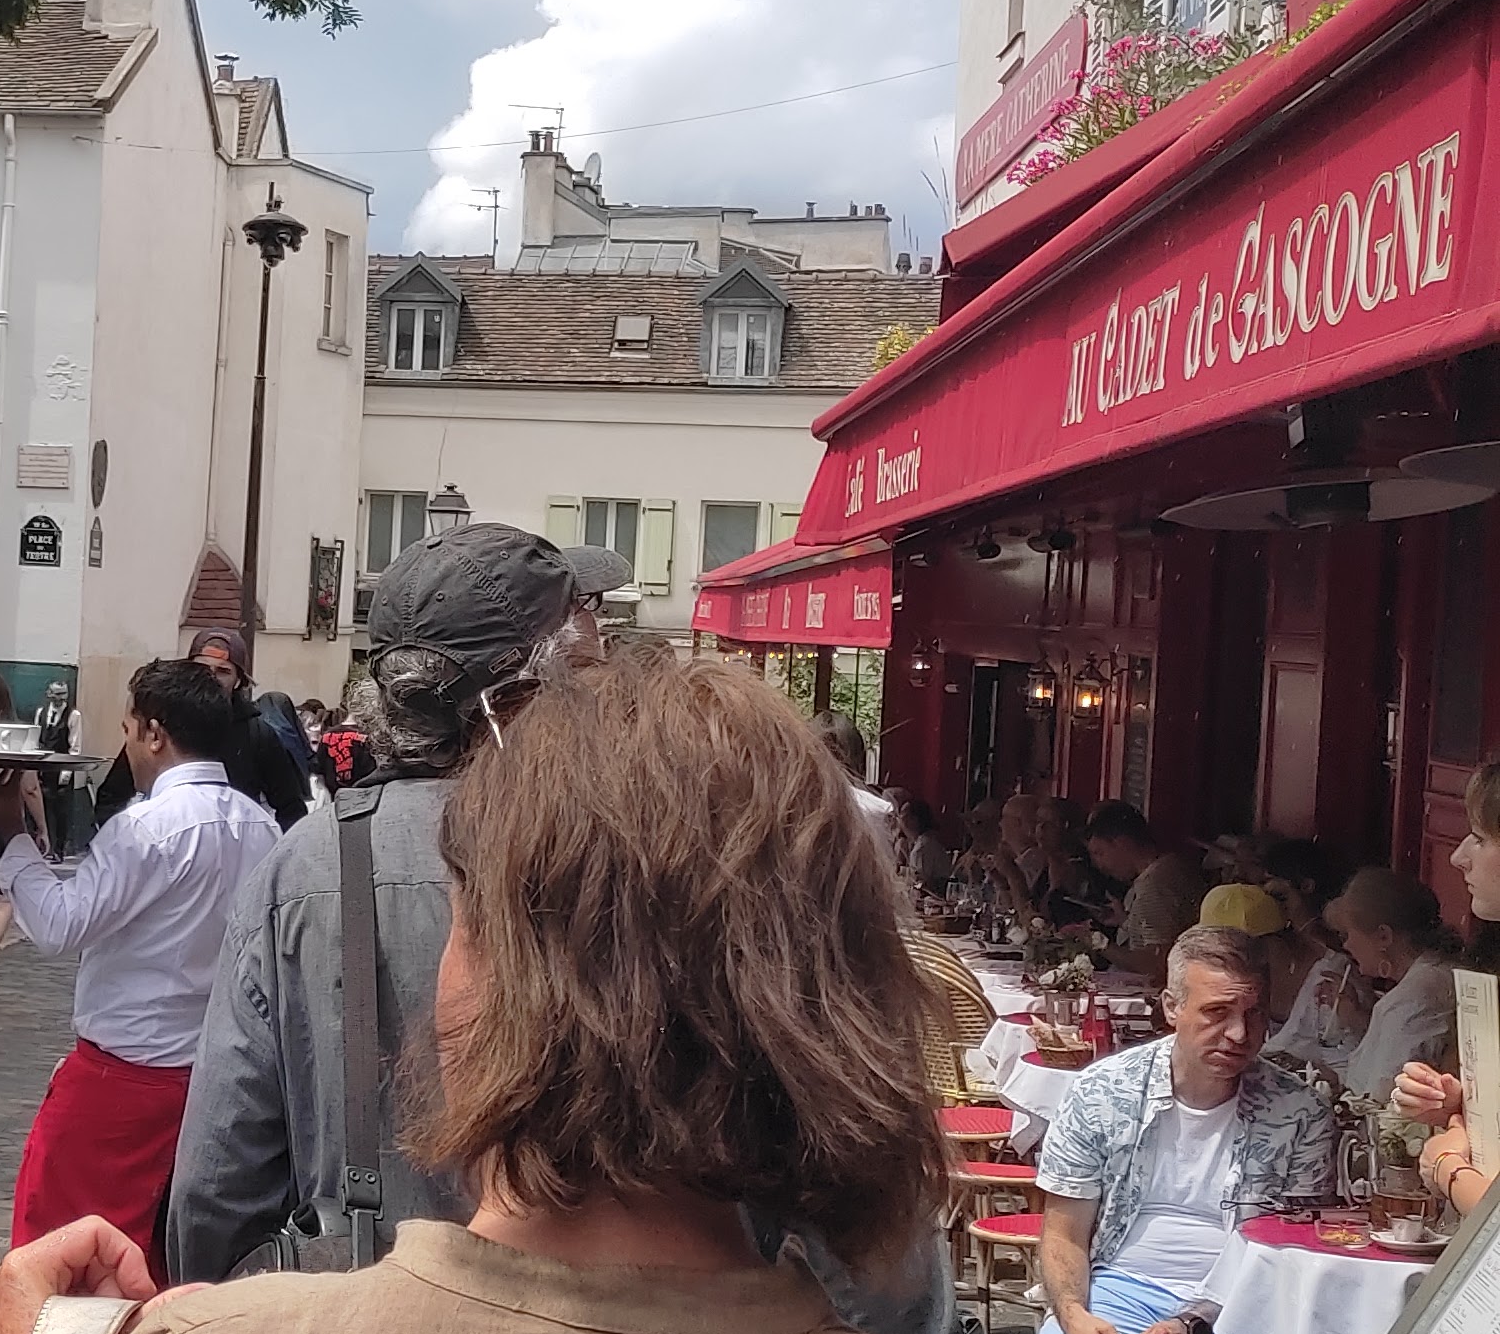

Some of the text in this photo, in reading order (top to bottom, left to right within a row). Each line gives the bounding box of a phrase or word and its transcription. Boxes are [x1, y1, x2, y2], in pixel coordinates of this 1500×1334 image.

[1005, 38, 1072, 145] CATHERINE
[1061, 131, 1460, 427] AU CADET de GASCOGNE
[844, 430, 921, 518] Café Brasserie
[25, 551, 55, 561] TERTRE
[28, 535, 54, 545] PLACE
